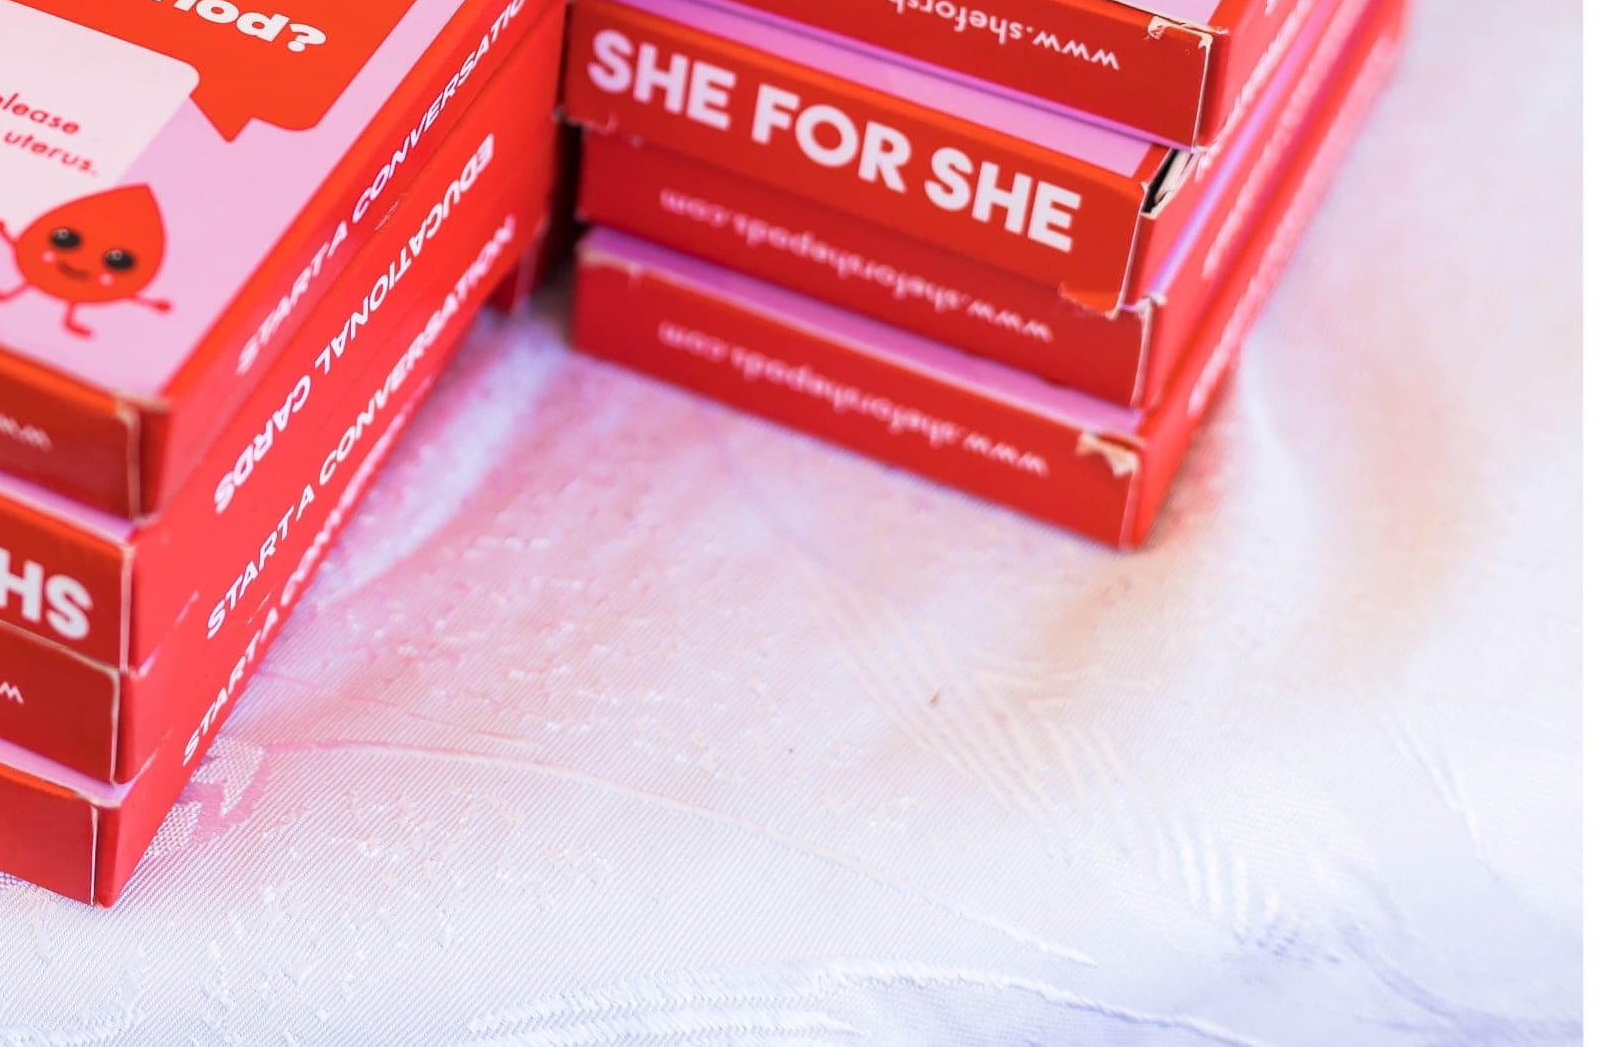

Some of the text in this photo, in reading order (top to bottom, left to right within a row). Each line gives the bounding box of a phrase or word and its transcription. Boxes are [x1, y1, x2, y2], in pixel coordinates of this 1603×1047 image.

[4, 131, 98, 177] uterus.
[587, 29, 1081, 253] SHE FOR SHE
[236, 244, 331, 375] START
[328, 222, 348, 256] A
[315, 134, 494, 374] EDUCATIONAL
[206, 508, 294, 639] START
[296, 485, 314, 520] A
[320, 214, 516, 486] CONVERSATION
[214, 375, 311, 514] CARDS
[183, 630, 261, 765] START
